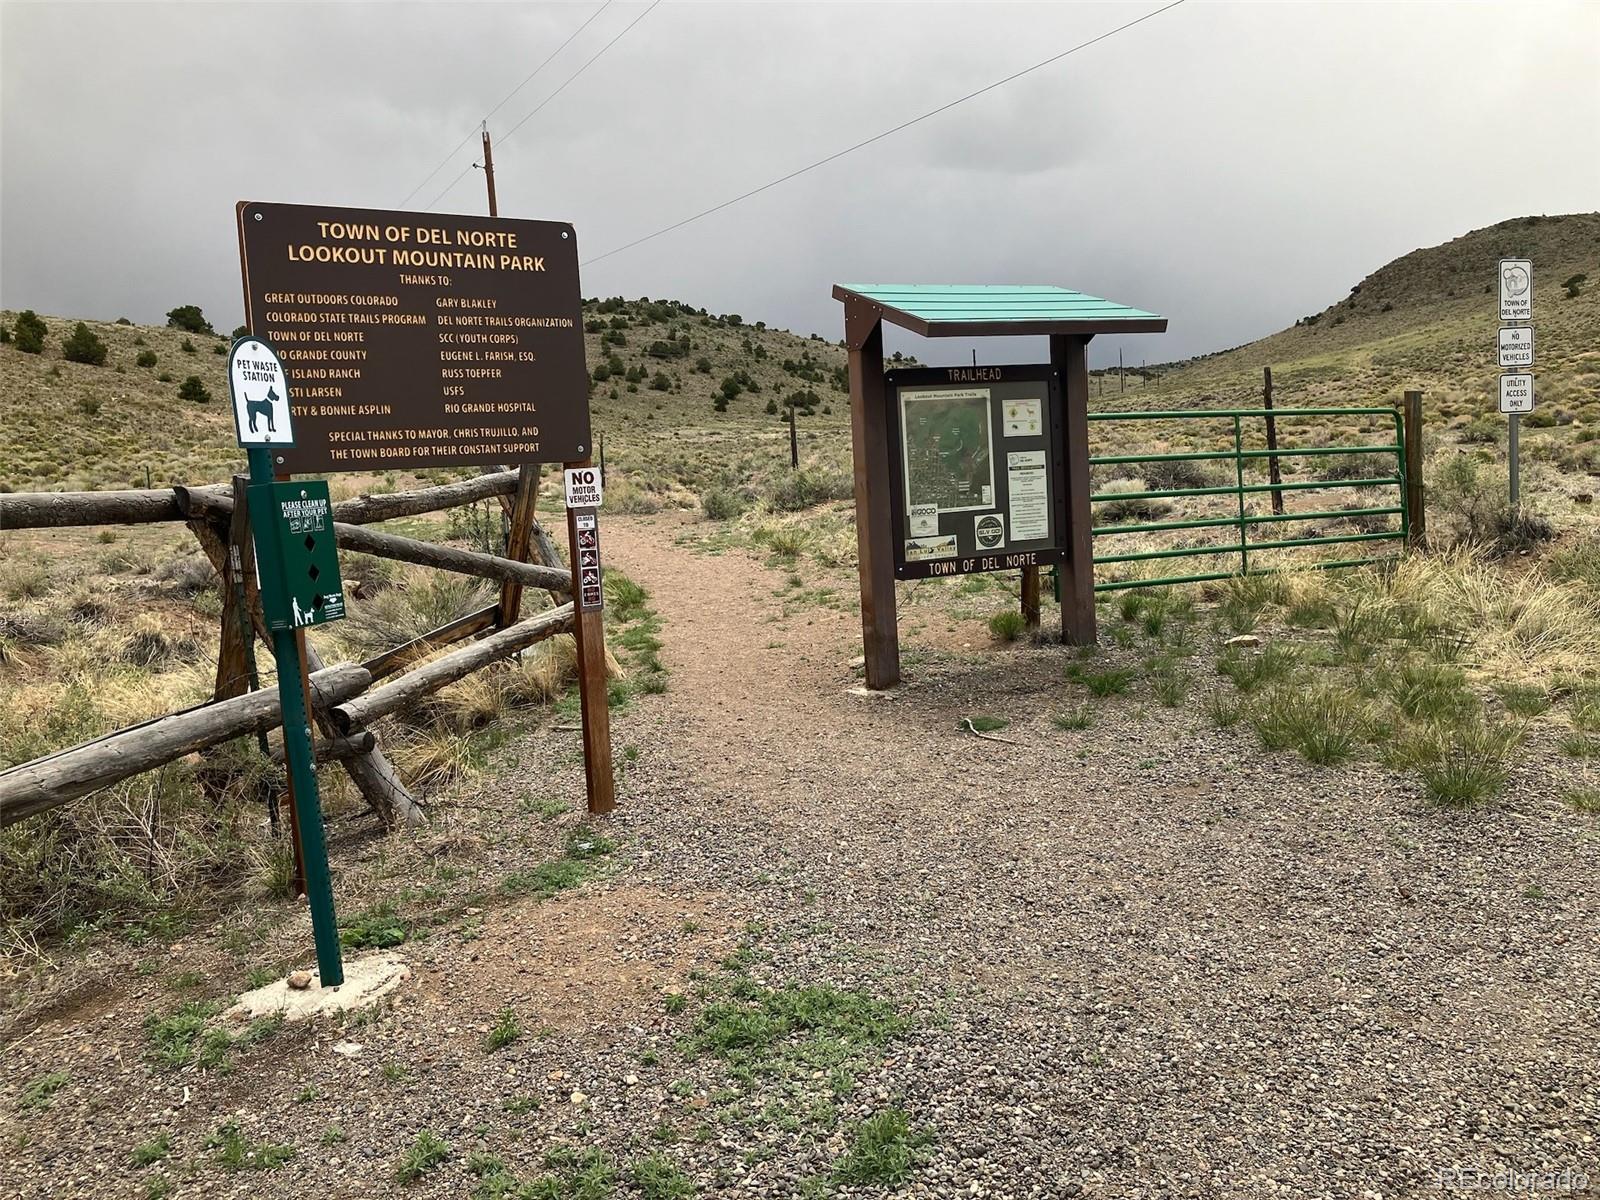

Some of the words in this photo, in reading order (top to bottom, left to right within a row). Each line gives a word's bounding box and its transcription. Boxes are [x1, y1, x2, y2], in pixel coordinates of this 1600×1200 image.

[317, 222, 380, 240] TOWN
[385, 226, 410, 242] OF
[416, 228, 452, 244] DEL
[456, 230, 517, 248] NORTE
[288, 244, 386, 264] LOOKOUT
[392, 250, 495, 269] MOUNTAIN
[500, 255, 546, 272] PARK
[400, 274, 436, 285] THANKS
[438, 276, 452, 286] TO:
[264, 293, 294, 304] GREAT
[298, 294, 348, 304] OUTDOORS
[350, 296, 398, 306] COLORADO
[436, 298, 458, 308] GARY
[460, 298, 496, 308] BLAKLEY
[266, 312, 317, 322] COLORADO
[320, 313, 346, 323] STATE
[348, 314, 380, 324] TRAILS
[382, 314, 426, 324] PROGRAM
[438, 316, 453, 326] DEL
[456, 316, 482, 326] NORTE
[484, 317, 512, 326] TRAILS
[514, 318, 572, 328] ORGANIZATION
[268, 330, 297, 341] TOWN
[300, 331, 312, 341] OF
[314, 332, 331, 342] DEL
[334, 332, 364, 342] NORTE
[439, 334, 454, 342] SCC
[456, 334, 488, 344] (YOUTH
[490, 334, 518, 344] CORPS)
[1500, 343, 1530, 351] MOTORIZED
[289, 350, 328, 360] GRANDE
[330, 350, 367, 360] COUNTY
[440, 351, 473, 360] EUGENE
[476, 352, 483, 360] L.
[485, 352, 516, 362] FARISH,
[518, 352, 536, 362] ESQ.
[237, 359, 250, 370] PET
[252, 361, 278, 372] WASTE
[242, 371, 275, 382] STATION
[292, 368, 326, 378] ISLAND
[329, 368, 360, 378] RANCH
[442, 368, 464, 378] RUSS
[466, 368, 502, 378] TOEPFER
[948, 368, 1002, 381] TRAILHEAD
[306, 387, 342, 398] LARSEN
[444, 386, 464, 396] USFS
[310, 406, 318, 416] &
[320, 405, 356, 416] BONNIE
[358, 404, 391, 414] ASPLIN
[444, 404, 460, 414] RIO
[462, 403, 495, 413] GRANDE
[498, 402, 536, 412] HOSPITAL
[328, 431, 366, 442] SPECIAL
[367, 430, 403, 440] THANKS
[404, 430, 416, 440] TO
[454, 428, 478, 438] CHRIS
[522, 426, 538, 436] AND
[330, 449, 348, 459] THE
[350, 448, 378, 458] TOWN
[380, 447, 410, 458] BOARD
[412, 446, 430, 456] FOR
[432, 446, 457, 455] THEIR
[459, 444, 500, 454] CONSTANT
[503, 442, 539, 453] SUPPORT
[572, 471, 594, 486] NO
[572, 486, 596, 494] MOTOR
[281, 501, 301, 510] PLEASE
[302, 500, 318, 508] CLEAN
[319, 499, 326, 507] UP
[569, 494, 600, 504] VEHICLES
[929, 561, 956, 575] TOWN
[962, 559, 975, 572] OF
[982, 558, 1000, 570] DEL
[1006, 553, 1036, 567] NORTE
